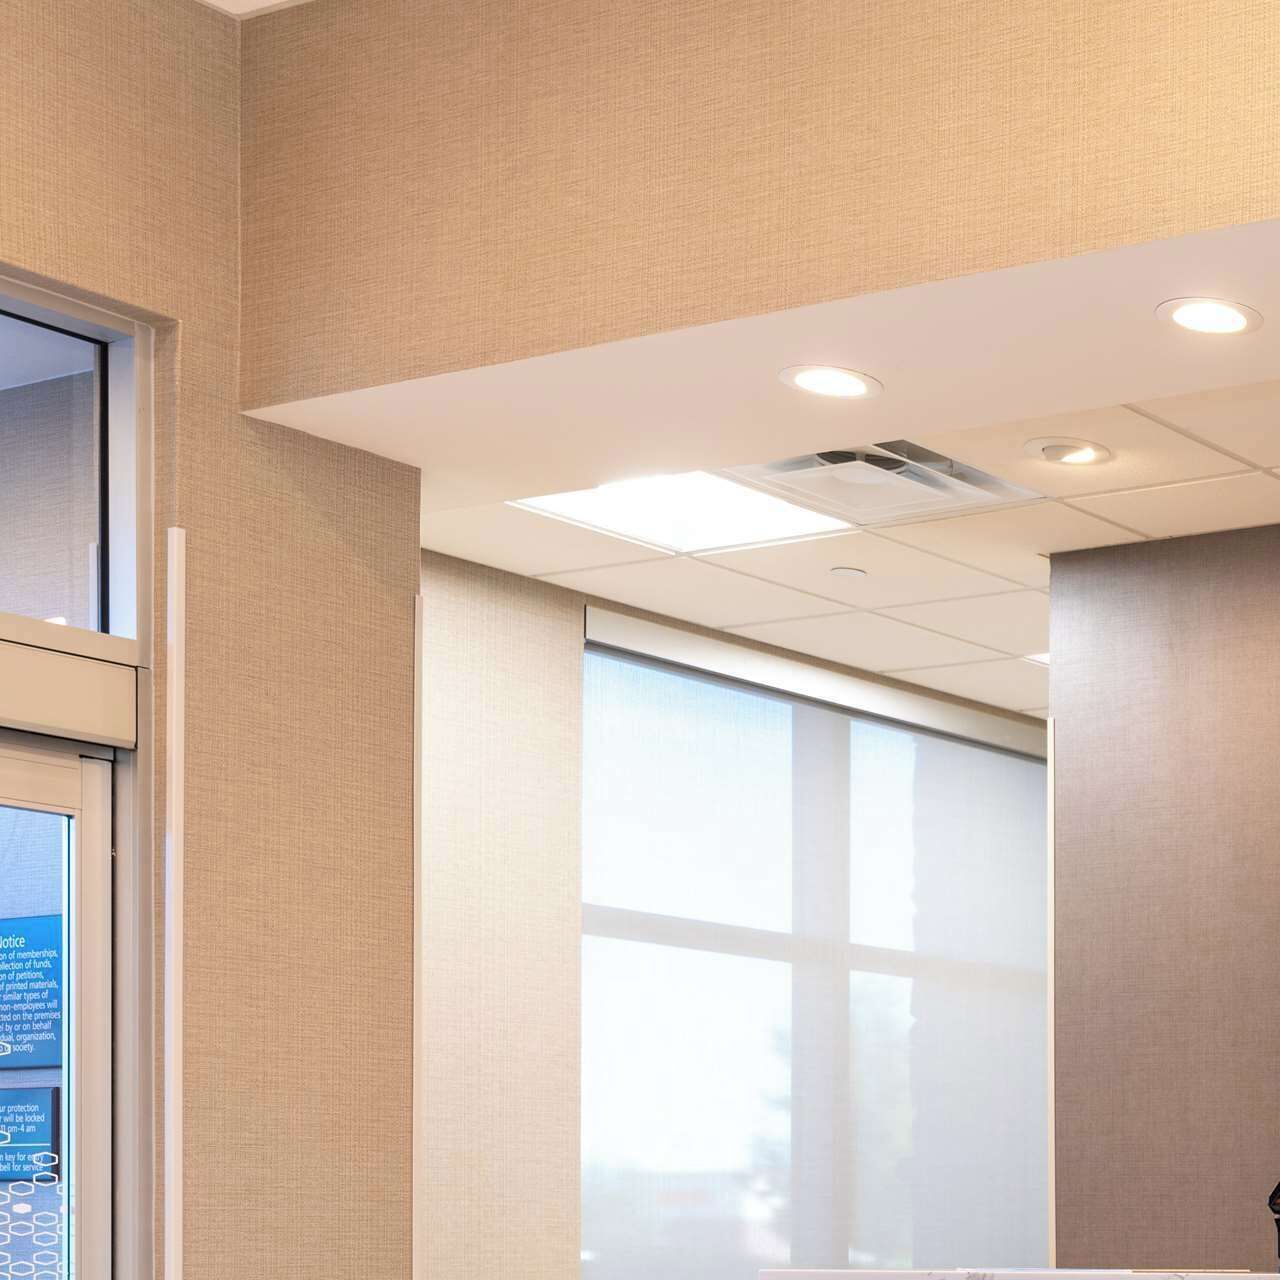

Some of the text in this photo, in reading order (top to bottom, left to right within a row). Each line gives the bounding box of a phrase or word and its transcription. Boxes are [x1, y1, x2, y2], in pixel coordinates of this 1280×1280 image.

[17, 949, 59, 959] memberships,
[25, 959, 32, 969] of
[33, 959, 53, 969] funds,
[8, 970, 15, 980] of
[16, 971, 44, 981] petitions,
[6, 981, 28, 992] printed
[29, 979, 59, 989] materials,
[24, 992, 41, 1003] types
[41, 989, 49, 999] of
[22, 1012, 33, 1021] the
[34, 1010, 62, 1021] premises
[32, 1019, 52, 1030] behalf
[16, 1031, 57, 1043] organization,
[7, 1104, 39, 1113] protection
[25, 1111, 45, 1122] locked
